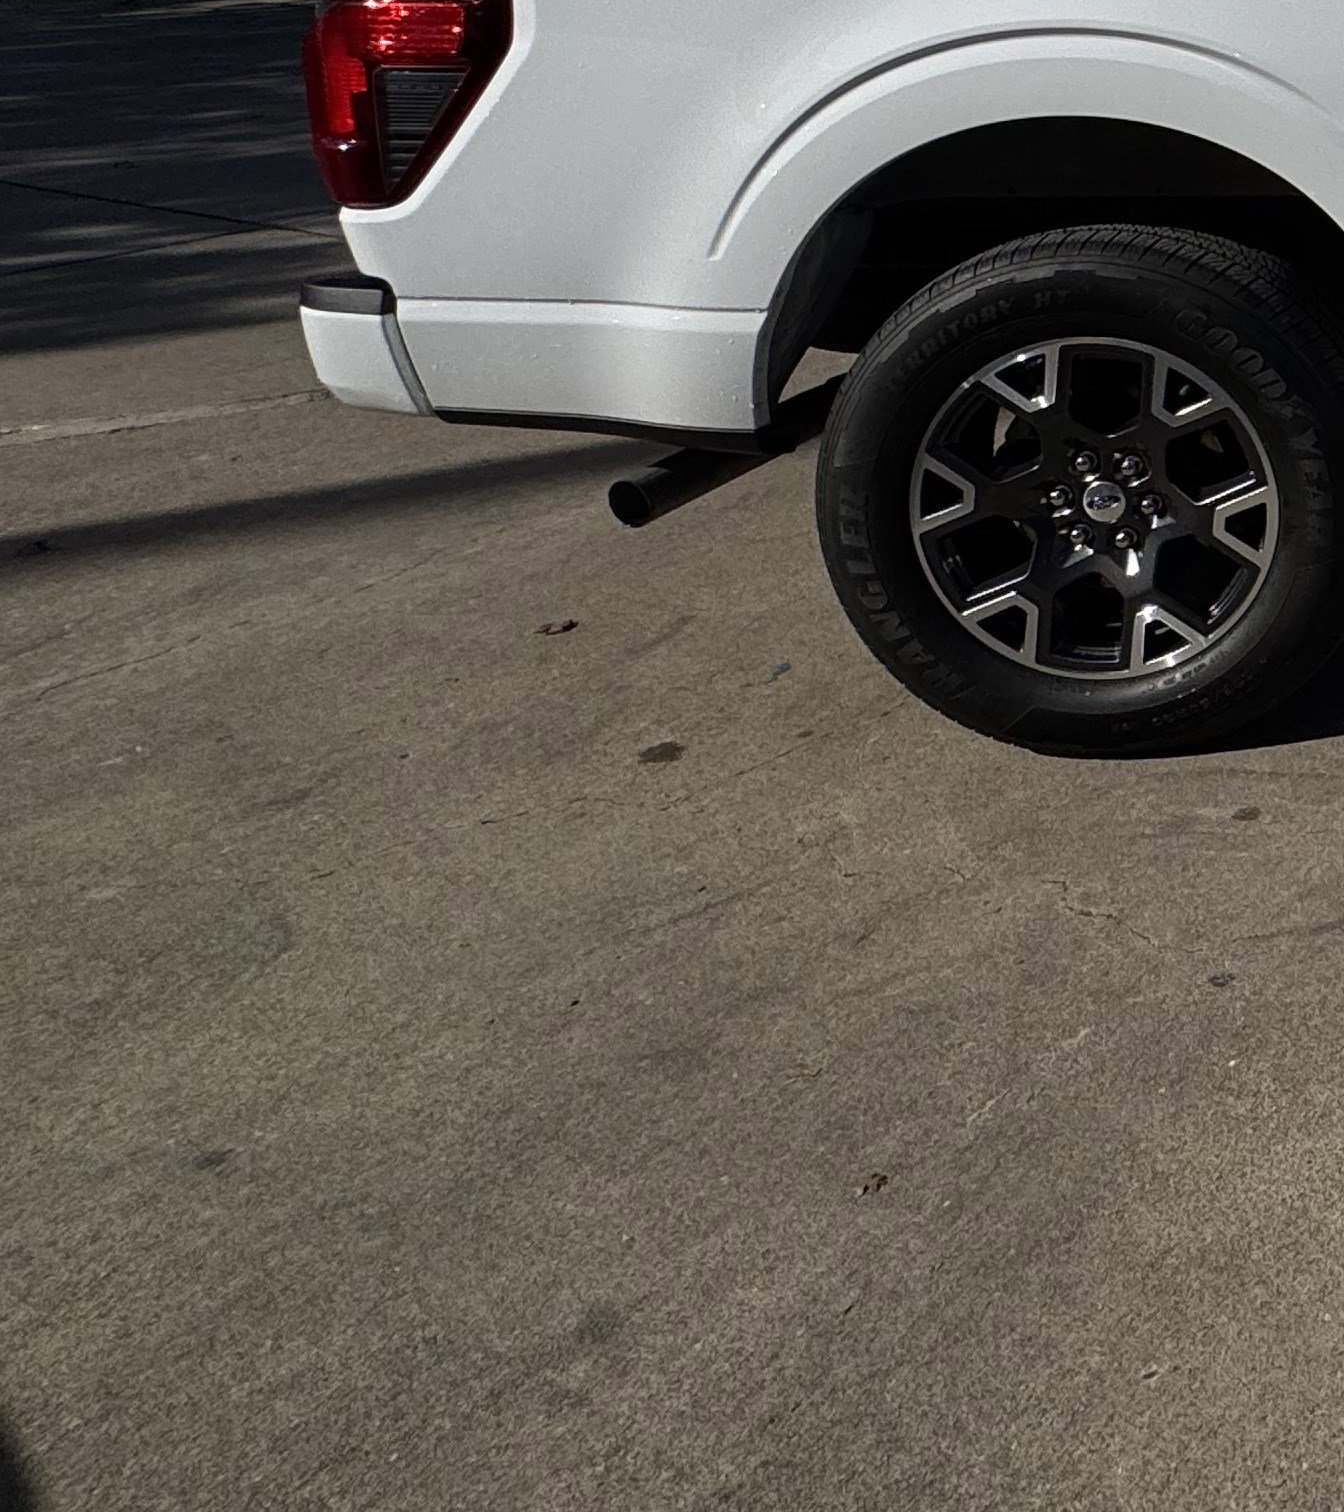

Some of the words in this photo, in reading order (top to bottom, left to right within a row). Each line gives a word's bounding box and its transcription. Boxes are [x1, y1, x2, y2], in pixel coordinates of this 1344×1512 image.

[889, 295, 1015, 386] RRITORY
[1174, 308, 1336, 546] GOODYEAR
[839, 485, 985, 710] RANGLER
